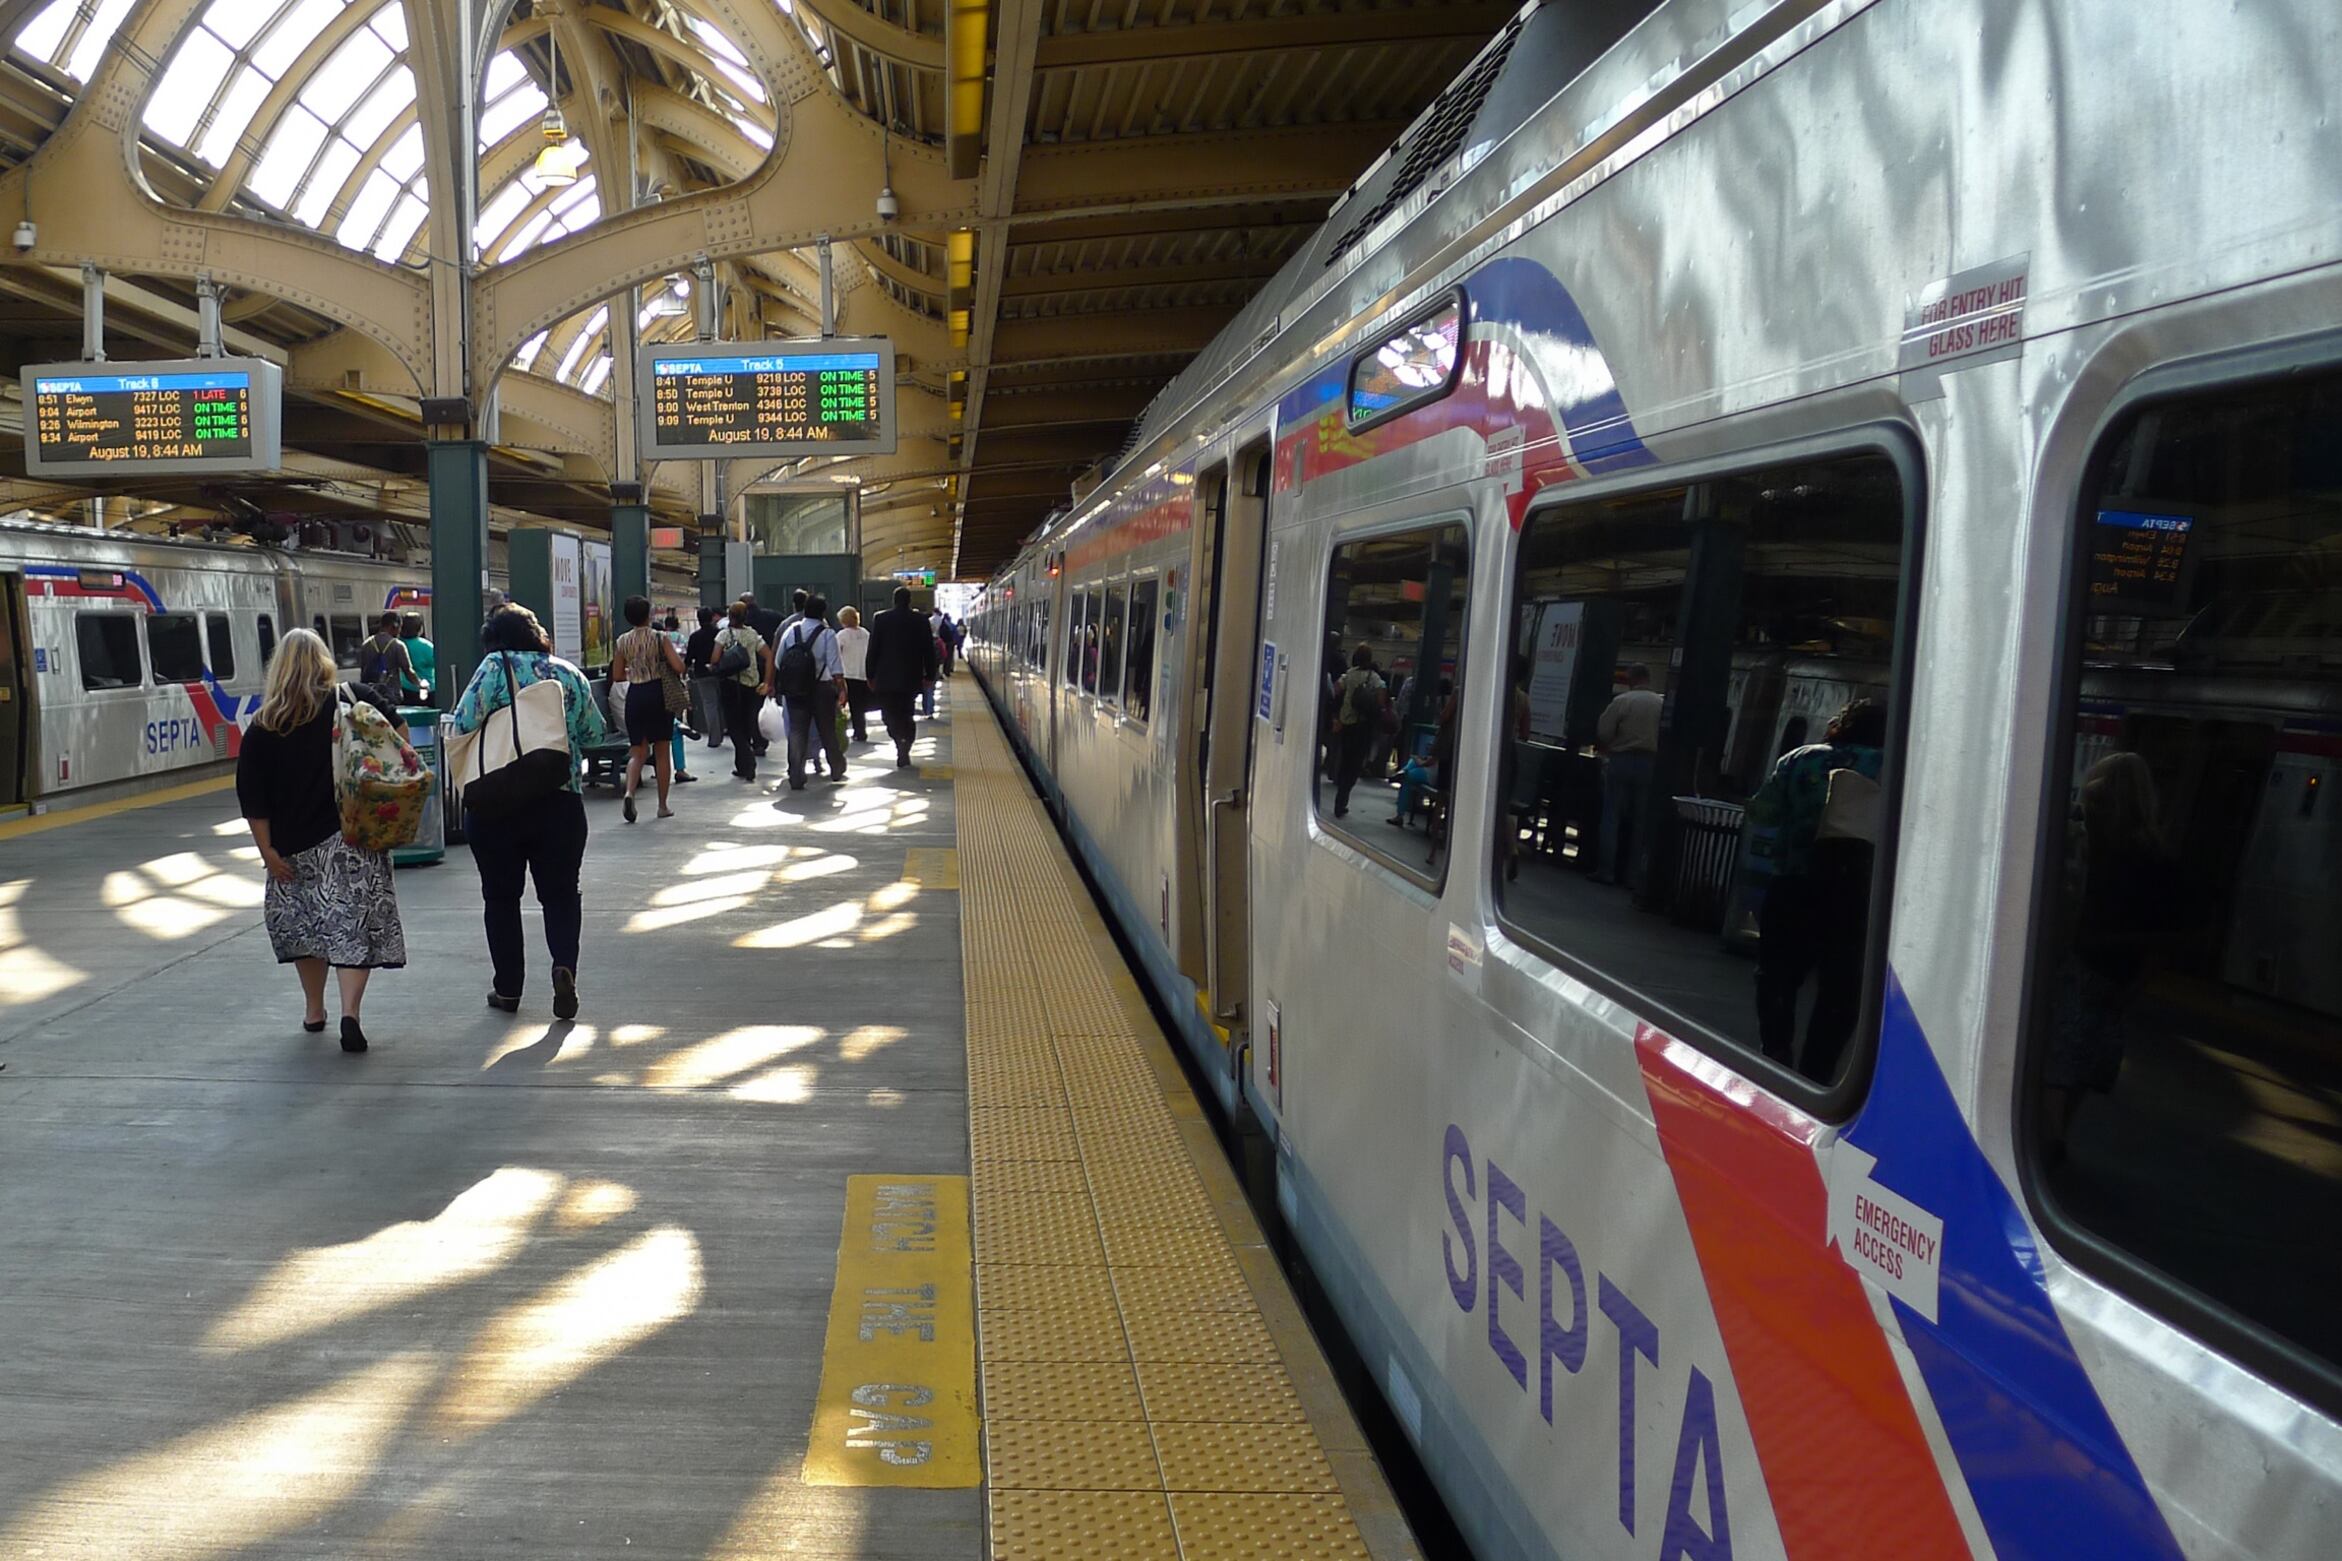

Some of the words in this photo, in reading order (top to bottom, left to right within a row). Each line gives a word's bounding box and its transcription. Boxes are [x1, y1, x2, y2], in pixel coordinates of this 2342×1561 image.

[1921, 299, 1948, 325] FOR
[1951, 284, 1997, 318] ENTRY
[2000, 276, 2024, 306] HIT
[1929, 324, 1974, 357] GLASS
[1978, 313, 2017, 346] HERE
[669, 364, 702, 374] SEPTA
[741, 359, 773, 371] Track
[118, 378, 149, 390] Track
[656, 376, 676, 387] 8:41
[685, 375, 722, 387] Temple
[724, 374, 733, 384] U
[757, 373, 781, 384] 9218
[783, 372, 806, 383] LOC
[820, 371, 836, 382] ON
[838, 370, 865, 381] TIME
[869, 370, 876, 380] 5
[50, 381, 82, 393] SEPTA
[656, 389, 678, 399] 8:50
[685, 388, 722, 400] Temple
[725, 387, 733, 398] U
[784, 386, 806, 396] LOC
[820, 384, 837, 395] ON
[838, 384, 865, 394] TIME
[869, 384, 876, 393] 5
[66, 394, 93, 405] Elwyn
[133, 392, 157, 402] 7327
[159, 391, 180, 401] LOC
[193, 391, 198, 400] 1
[202, 390, 226, 400] LATE
[240, 389, 246, 399] 6
[657, 402, 679, 413] 9:00
[686, 401, 711, 412] West
[712, 401, 750, 411] Trenton
[784, 399, 807, 409] LOC
[821, 398, 837, 408] ON
[839, 397, 865, 408] TIME
[869, 397, 876, 407] 5
[39, 407, 59, 418] 9:04
[66, 407, 97, 418] Airport
[159, 404, 181, 414] LOC
[194, 402, 210, 413] ON
[212, 402, 236, 413] TIME
[240, 402, 247, 412] 6
[686, 414, 723, 426] Temple
[726, 414, 734, 424] U
[758, 412, 783, 423] 9344
[784, 412, 807, 422] LOC
[821, 411, 838, 422] ON
[839, 410, 866, 421] TIME
[870, 410, 877, 420] 5
[67, 418, 119, 431] Wilmington
[135, 417, 158, 428] 3223
[160, 417, 182, 427] LOC
[195, 416, 210, 427] ON
[212, 415, 237, 426] TIME
[241, 415, 248, 425] 6
[68, 432, 99, 444] Airport
[161, 429, 182, 440] LOC
[196, 429, 211, 439] ON
[214, 428, 238, 439] TIME
[242, 428, 248, 438] 6
[708, 430, 750, 444] August
[755, 429, 773, 442] 19,
[775, 427, 803, 440] 8:44
[806, 426, 828, 439] AM
[89, 446, 130, 460] August
[153, 445, 178, 458] 8:44
[182, 444, 202, 457] AM
[555, 558, 571, 583] MOVE
[147, 718, 200, 754] SEPTA
[871, 1183, 936, 1252] WATCH
[1855, 1194, 1936, 1265] EMERGENCY
[1854, 1227, 1903, 1280] ACCESS
[859, 1282, 936, 1342] THE
[1442, 1122, 1734, 1561] SEPTA
[846, 1383, 934, 1465] GAP
